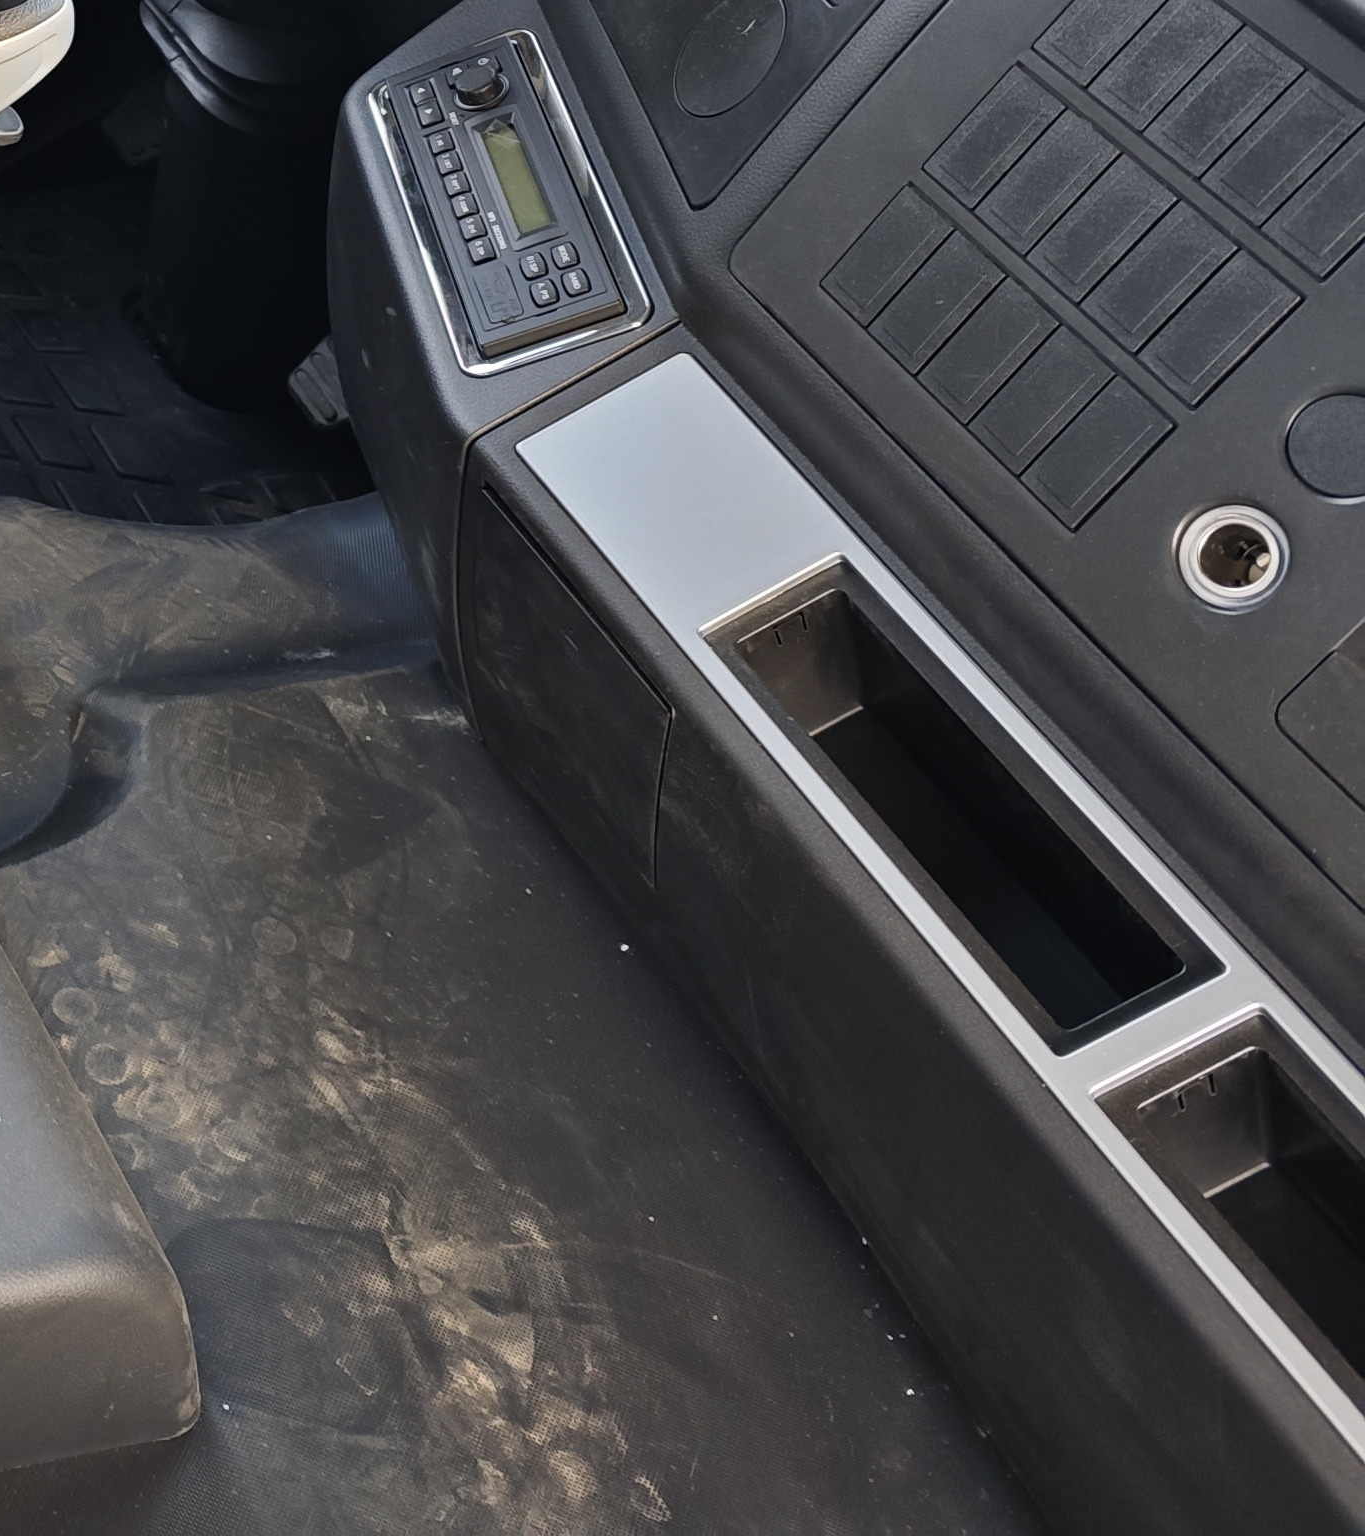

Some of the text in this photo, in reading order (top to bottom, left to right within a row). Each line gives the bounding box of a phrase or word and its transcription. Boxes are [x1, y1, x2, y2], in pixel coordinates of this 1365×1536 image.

[556, 244, 571, 263] MODE
[525, 254, 539, 273] DISP
[567, 271, 582, 290] BAND
